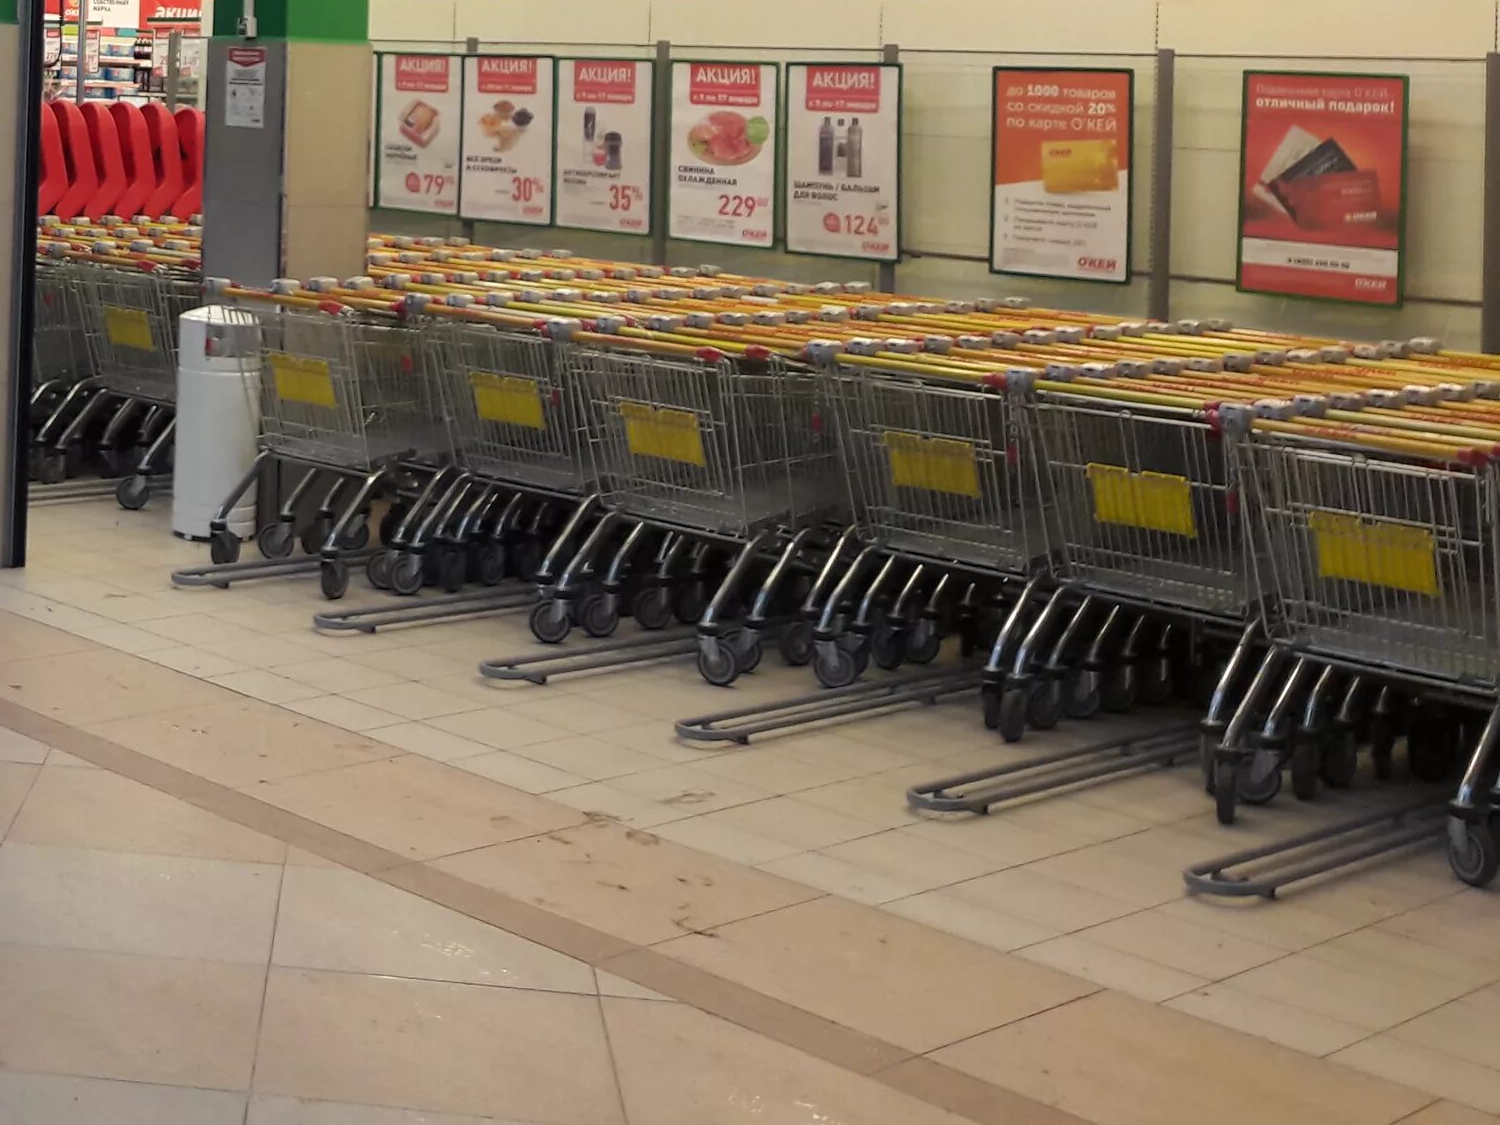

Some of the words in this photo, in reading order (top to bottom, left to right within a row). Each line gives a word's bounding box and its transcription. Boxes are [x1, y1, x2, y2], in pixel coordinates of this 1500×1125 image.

[155, 5, 204, 18] акци
[399, 58, 447, 74] АКЦИЯ!
[481, 59, 533, 74] АКЦИЯ!
[579, 66, 632, 83] АКЦИЯ!
[696, 66, 756, 85] АКЦИЯ!
[812, 71, 876, 91] АКЦИЯ!
[1063, 88, 1117, 101] товаров
[1007, 102, 1024, 112] со
[1028, 102, 1084, 115] скидкой
[1088, 102, 1117, 115] 20%
[1255, 96, 1325, 111] отличный
[1328, 100, 1395, 115] подарок!
[1006, 117, 1024, 127] по
[1071, 117, 1117, 132] О'КЕЙ
[677, 165, 716, 176] СВИНИНА
[423, 173, 445, 196] 79
[677, 175, 738, 187] ОХЛАЖДЕННАЯ
[717, 193, 757, 217] 229
[844, 213, 880, 236] 124
[1077, 255, 1117, 272] О'КЕЙ
